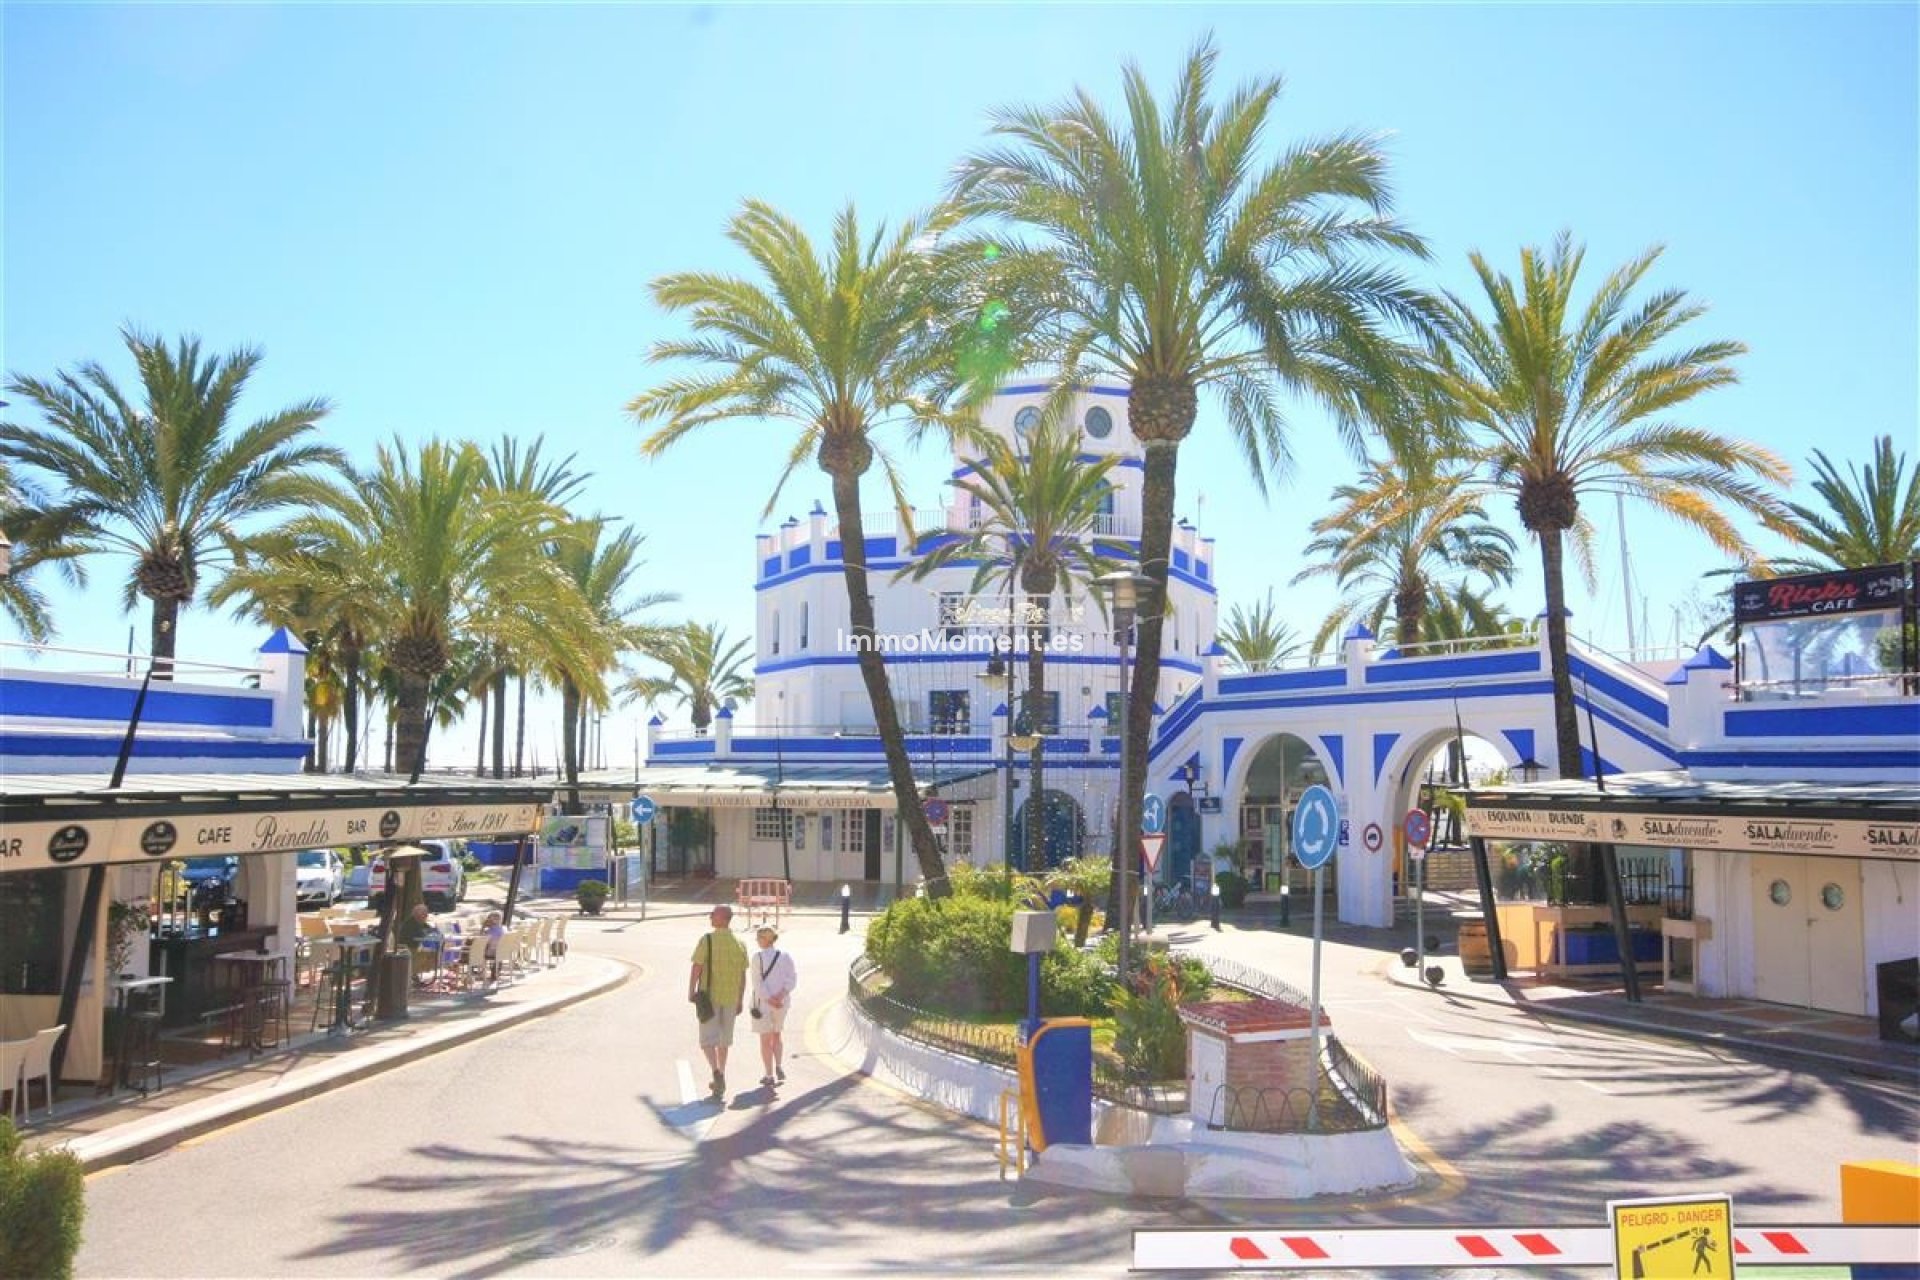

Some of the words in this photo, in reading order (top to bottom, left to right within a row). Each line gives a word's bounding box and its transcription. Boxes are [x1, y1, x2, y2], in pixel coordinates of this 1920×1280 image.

[1768, 581, 1860, 608] Ricks
[1812, 598, 1857, 612] CAFE
[1487, 810, 1532, 823] ESQUINITA
[1548, 813, 1585, 825] DUENDE
[197, 827, 232, 845] CAFE
[251, 815, 330, 850] Reinaldo
[346, 820, 367, 835] BAR
[1747, 824, 1832, 842] SALAduende
[1621, 1212, 1669, 1227] PELIGRO
[1677, 1208, 1723, 1223] DANGER
